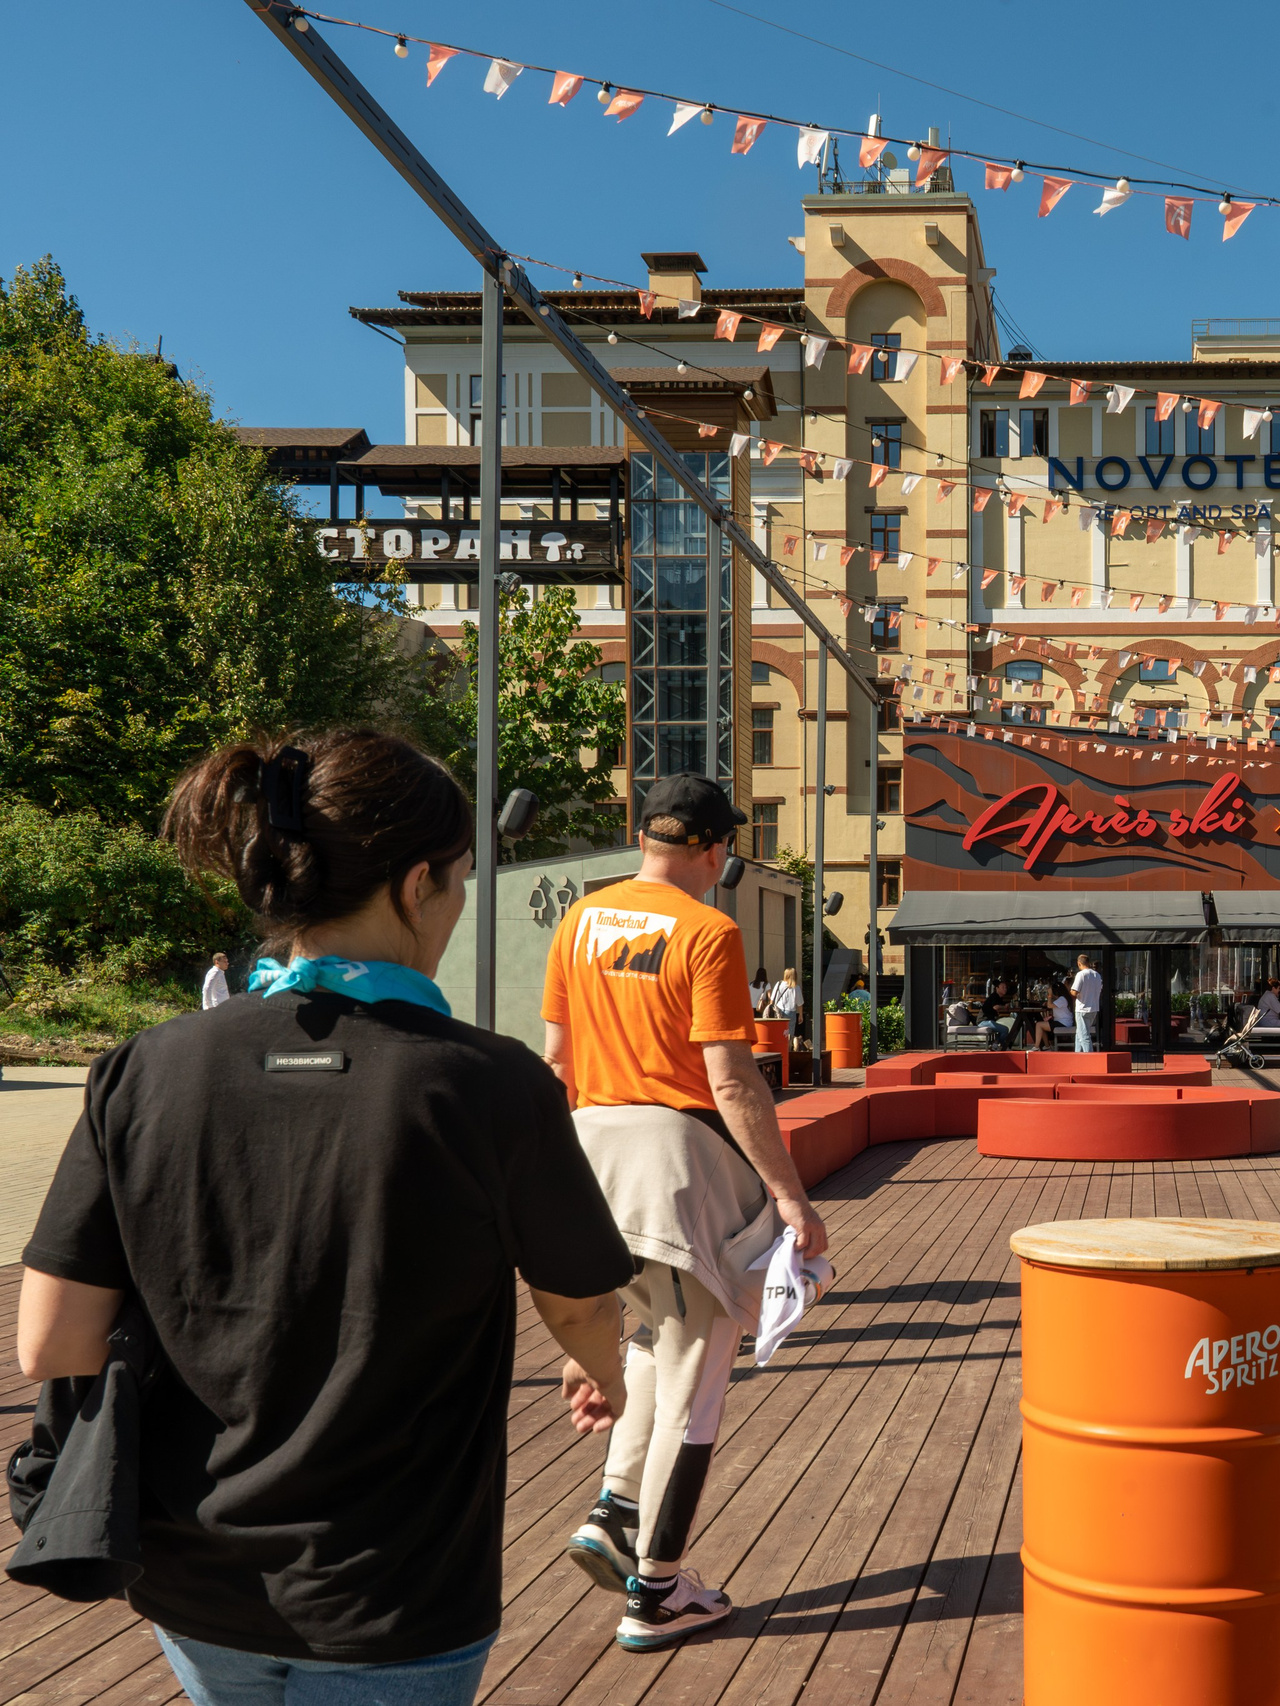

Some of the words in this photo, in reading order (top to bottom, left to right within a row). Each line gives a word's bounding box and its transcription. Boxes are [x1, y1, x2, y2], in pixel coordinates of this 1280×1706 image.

[1094, 505, 1171, 520] REORT
[1177, 505, 1222, 520] AND
[1231, 505, 1272, 520] SPA
[314, 528, 532, 561] СТОРАН
[962, 783, 1158, 870] Après
[1168, 772, 1247, 837] ski
[596, 911, 649, 930] Timberland
[1205, 1353, 1279, 1395] SPRiTZ
